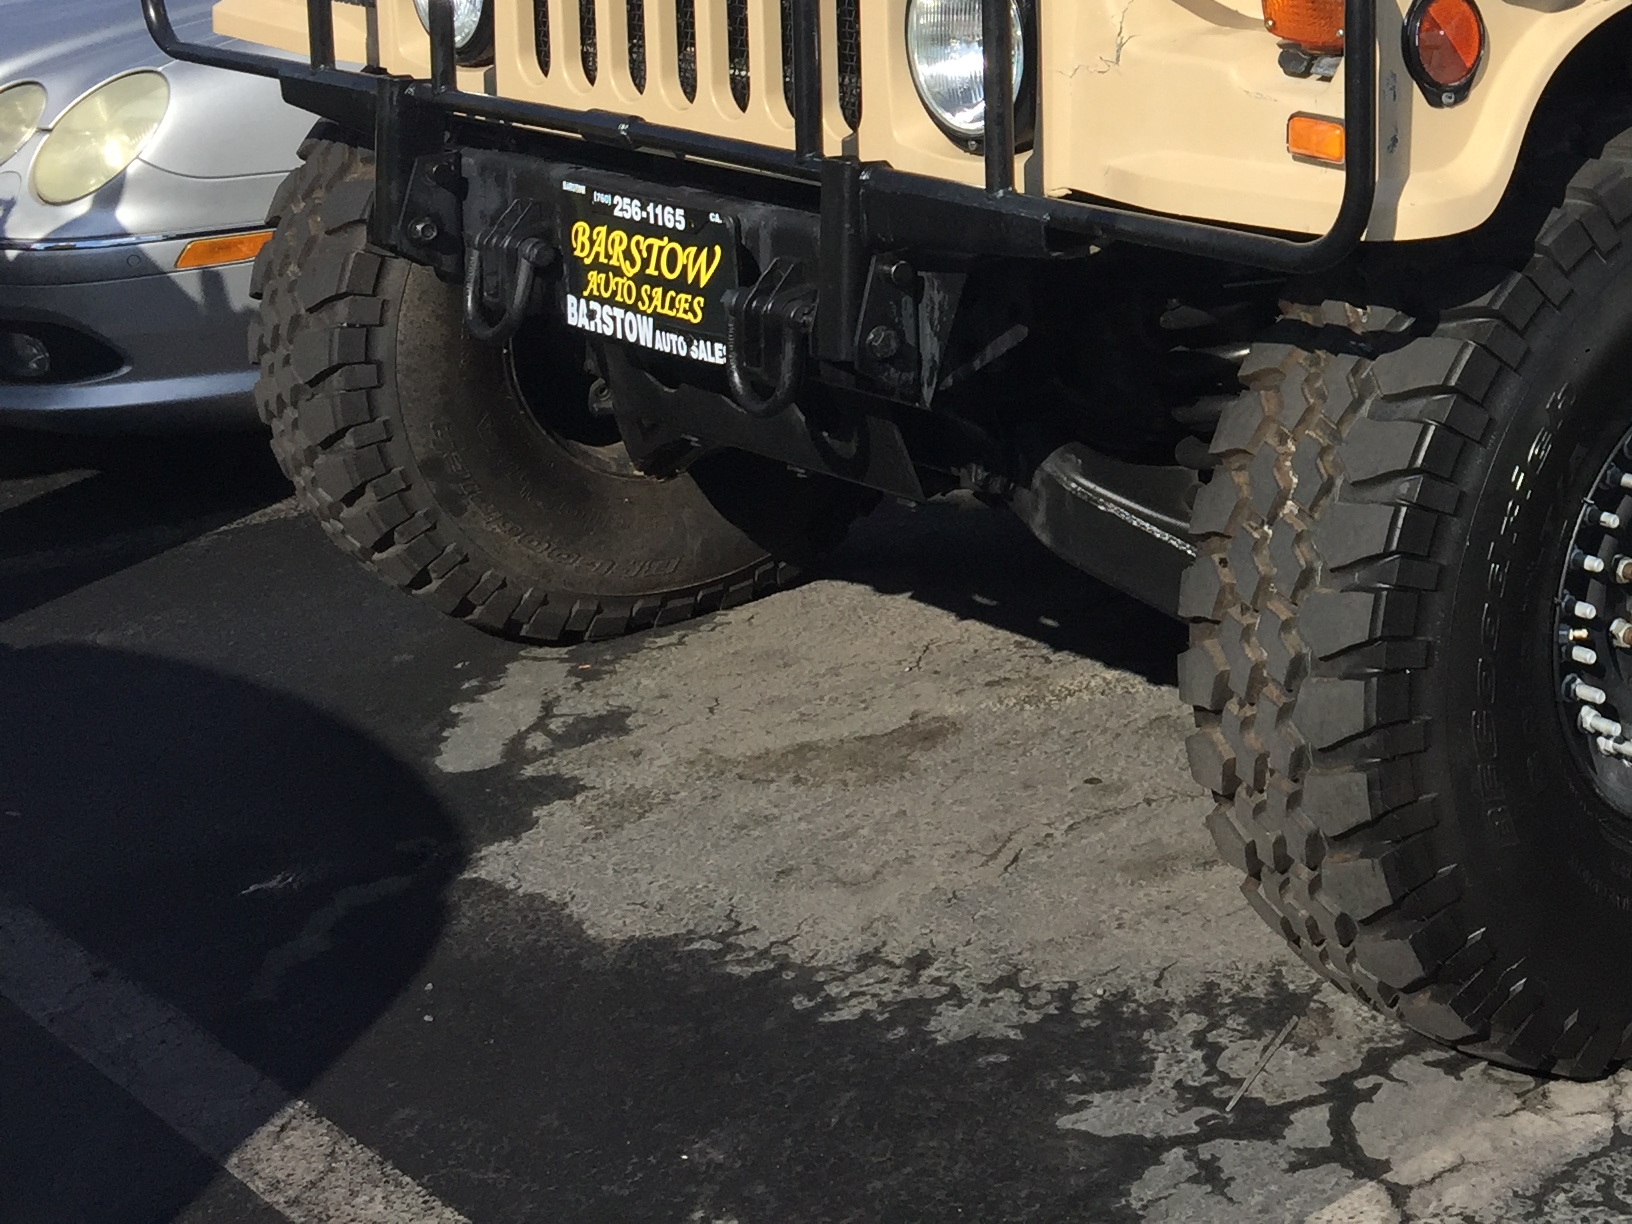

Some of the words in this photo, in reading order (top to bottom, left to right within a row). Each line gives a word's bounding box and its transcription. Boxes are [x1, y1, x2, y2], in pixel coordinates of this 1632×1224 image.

[613, 194, 686, 231] 256-1165
[571, 220, 722, 288] BARSTOW
[566, 293, 654, 348] BARSTOW
[654, 329, 687, 356] AUTO
[583, 269, 637, 305] AUTO
[638, 283, 705, 324] SALES
